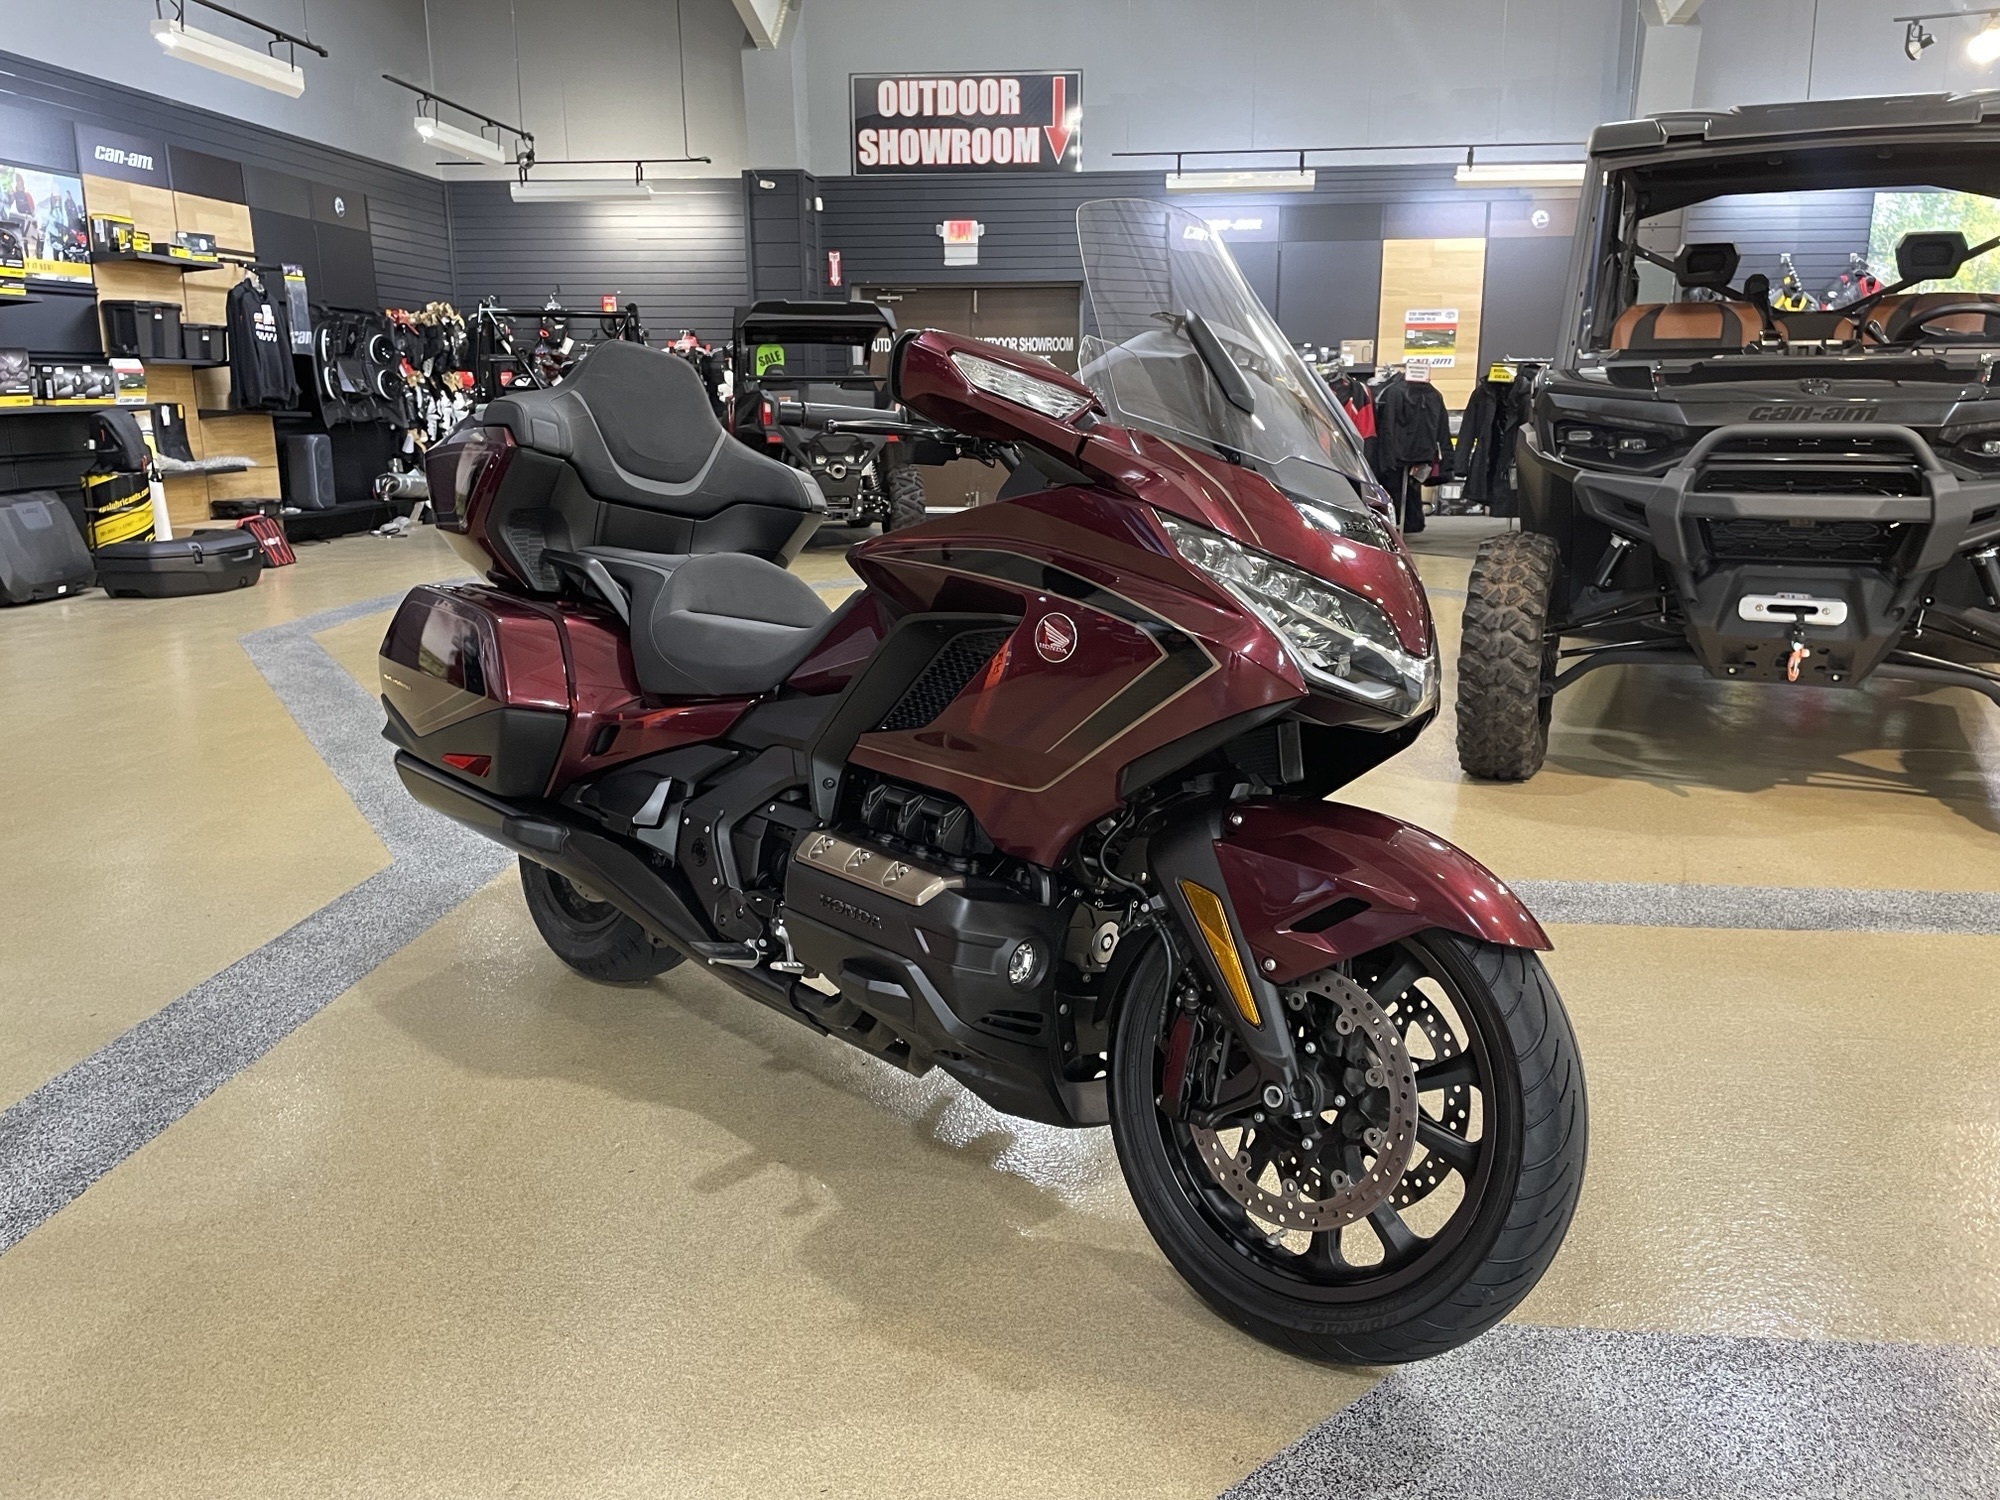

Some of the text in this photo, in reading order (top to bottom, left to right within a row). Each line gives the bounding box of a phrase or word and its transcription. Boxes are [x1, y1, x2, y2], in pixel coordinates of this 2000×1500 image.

[877, 79, 1021, 118] OUTDOOR
[858, 127, 1041, 166] SHOWROOM
[1019, 336, 1074, 352] SHOWROOM
[758, 350, 782, 367] SALE
[1747, 406, 1880, 422] can-am
[1039, 641, 1068, 655] HONDA
[820, 893, 884, 930] HONDA
